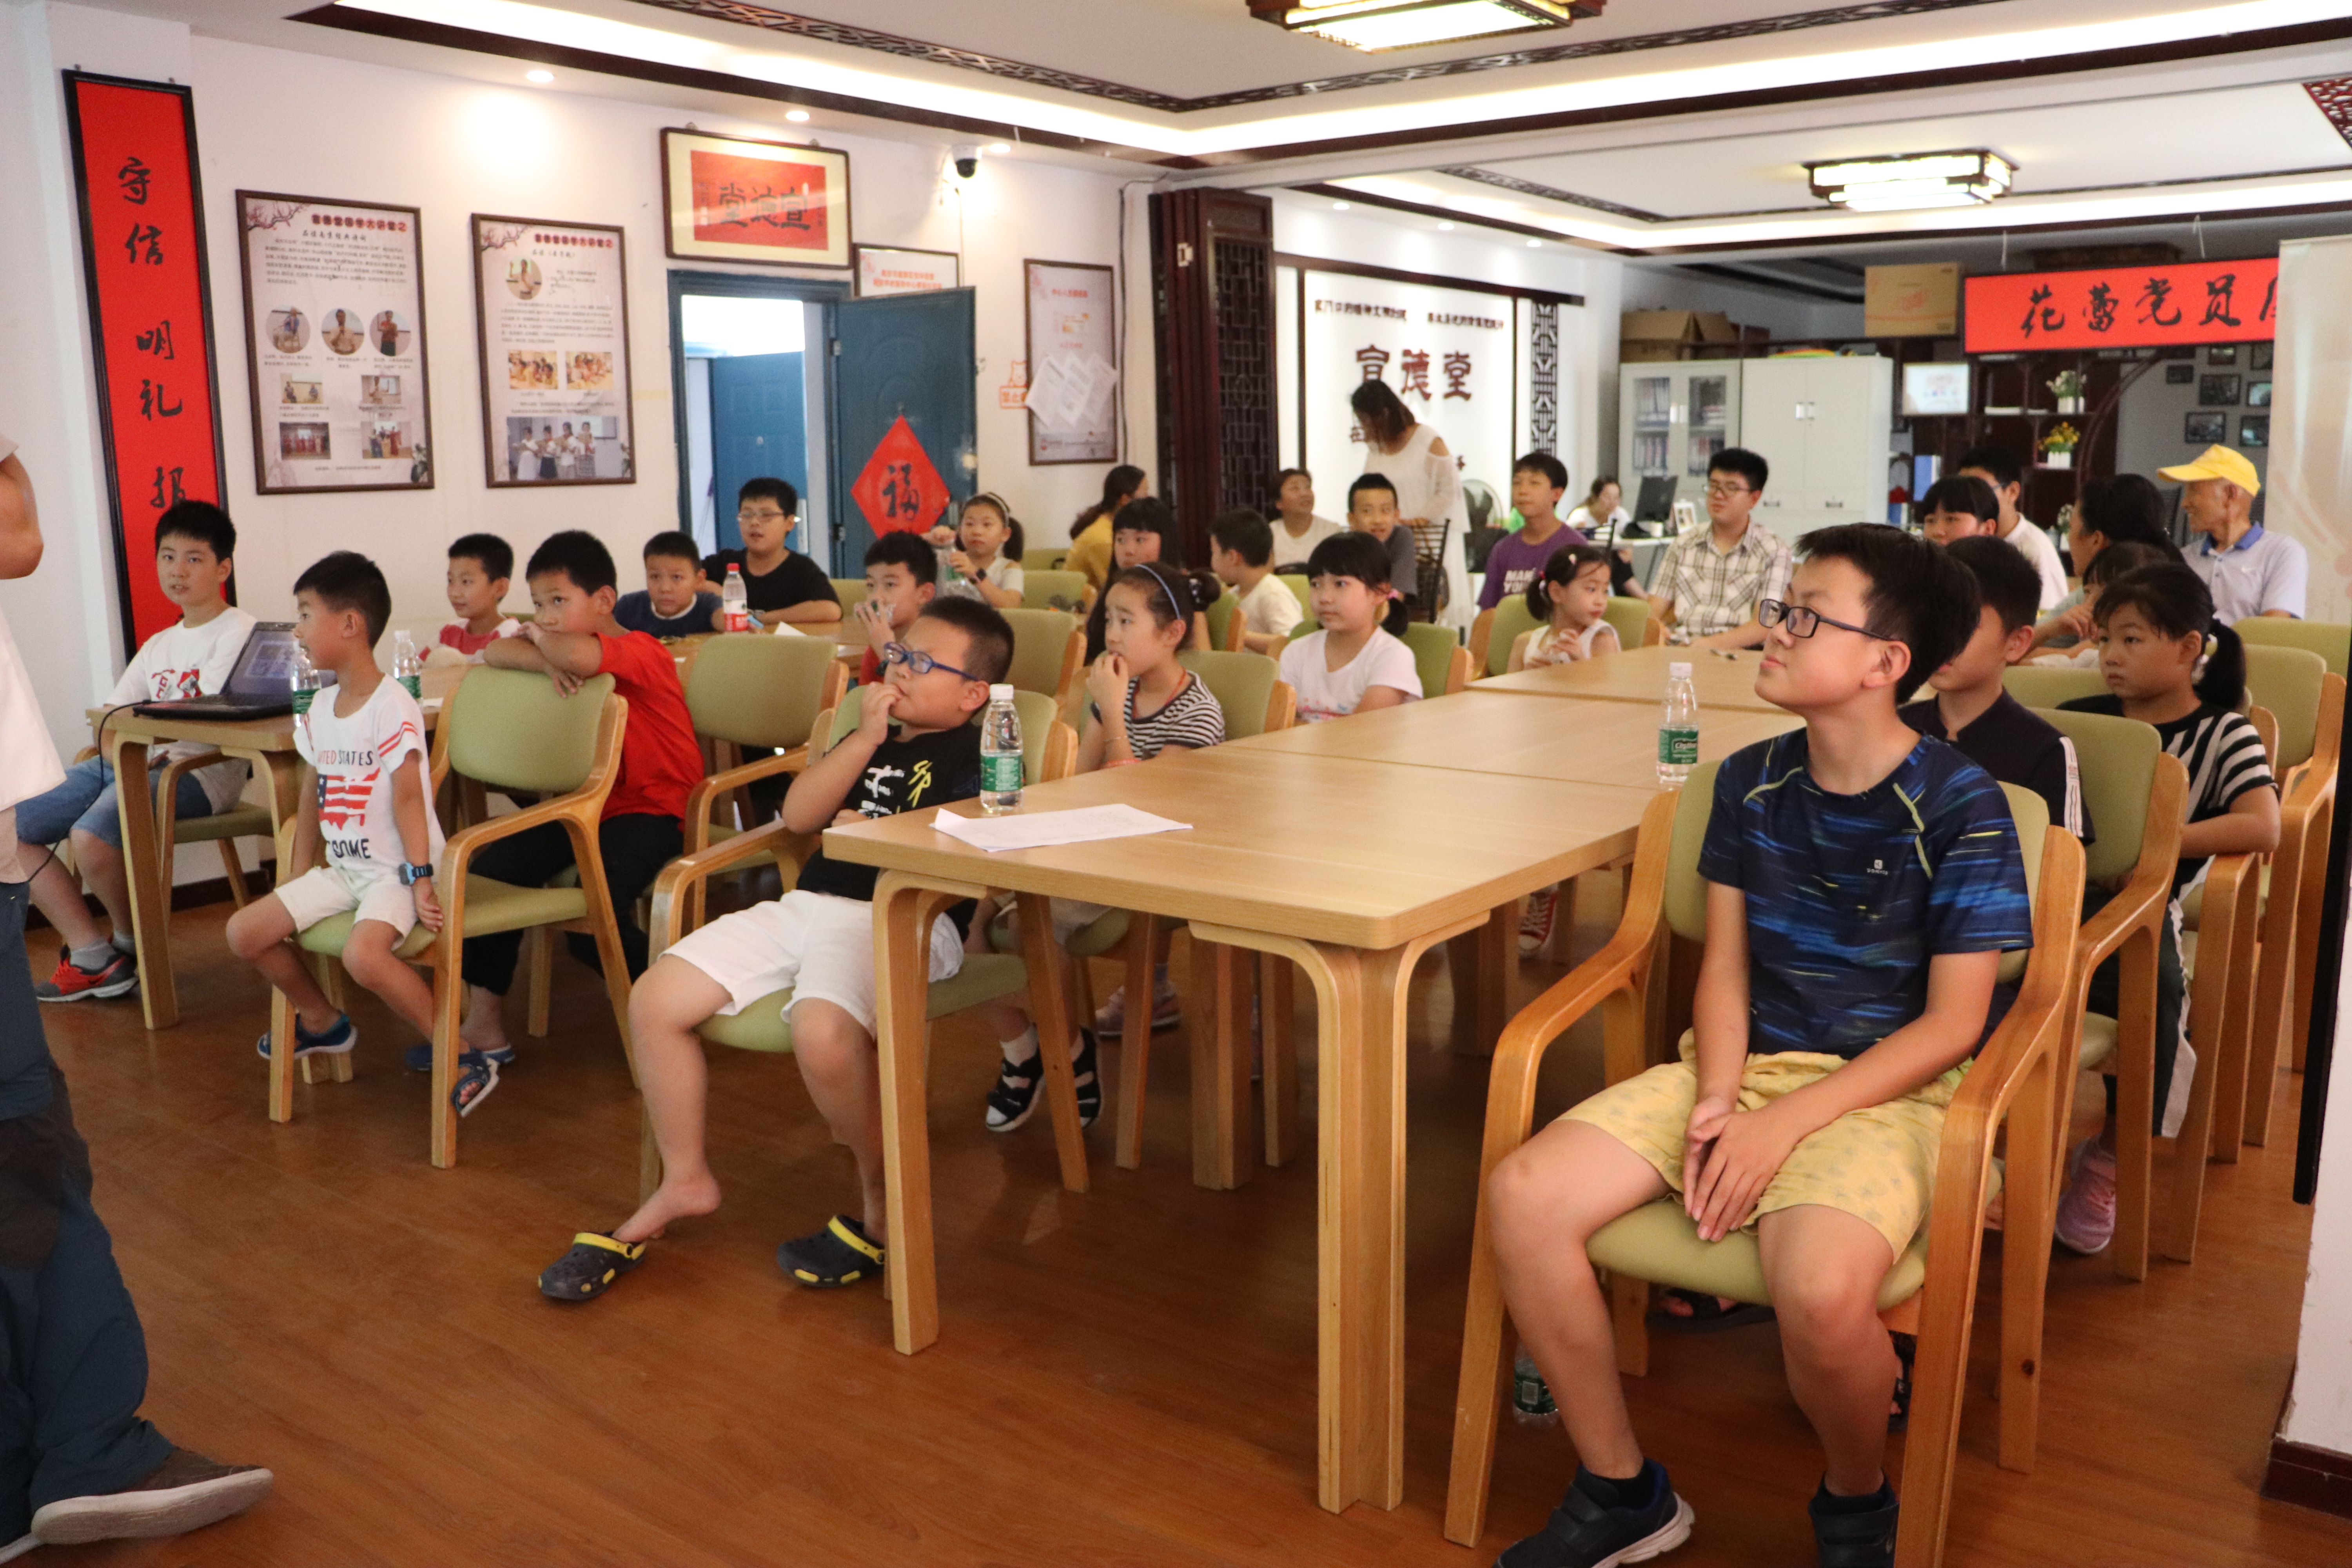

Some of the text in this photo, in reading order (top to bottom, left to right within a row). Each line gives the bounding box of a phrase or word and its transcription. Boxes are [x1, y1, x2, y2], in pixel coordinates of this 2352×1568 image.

[882, 463, 920, 521] 福
[338, 750, 374, 765] STATES
[327, 838, 371, 858] SOME
